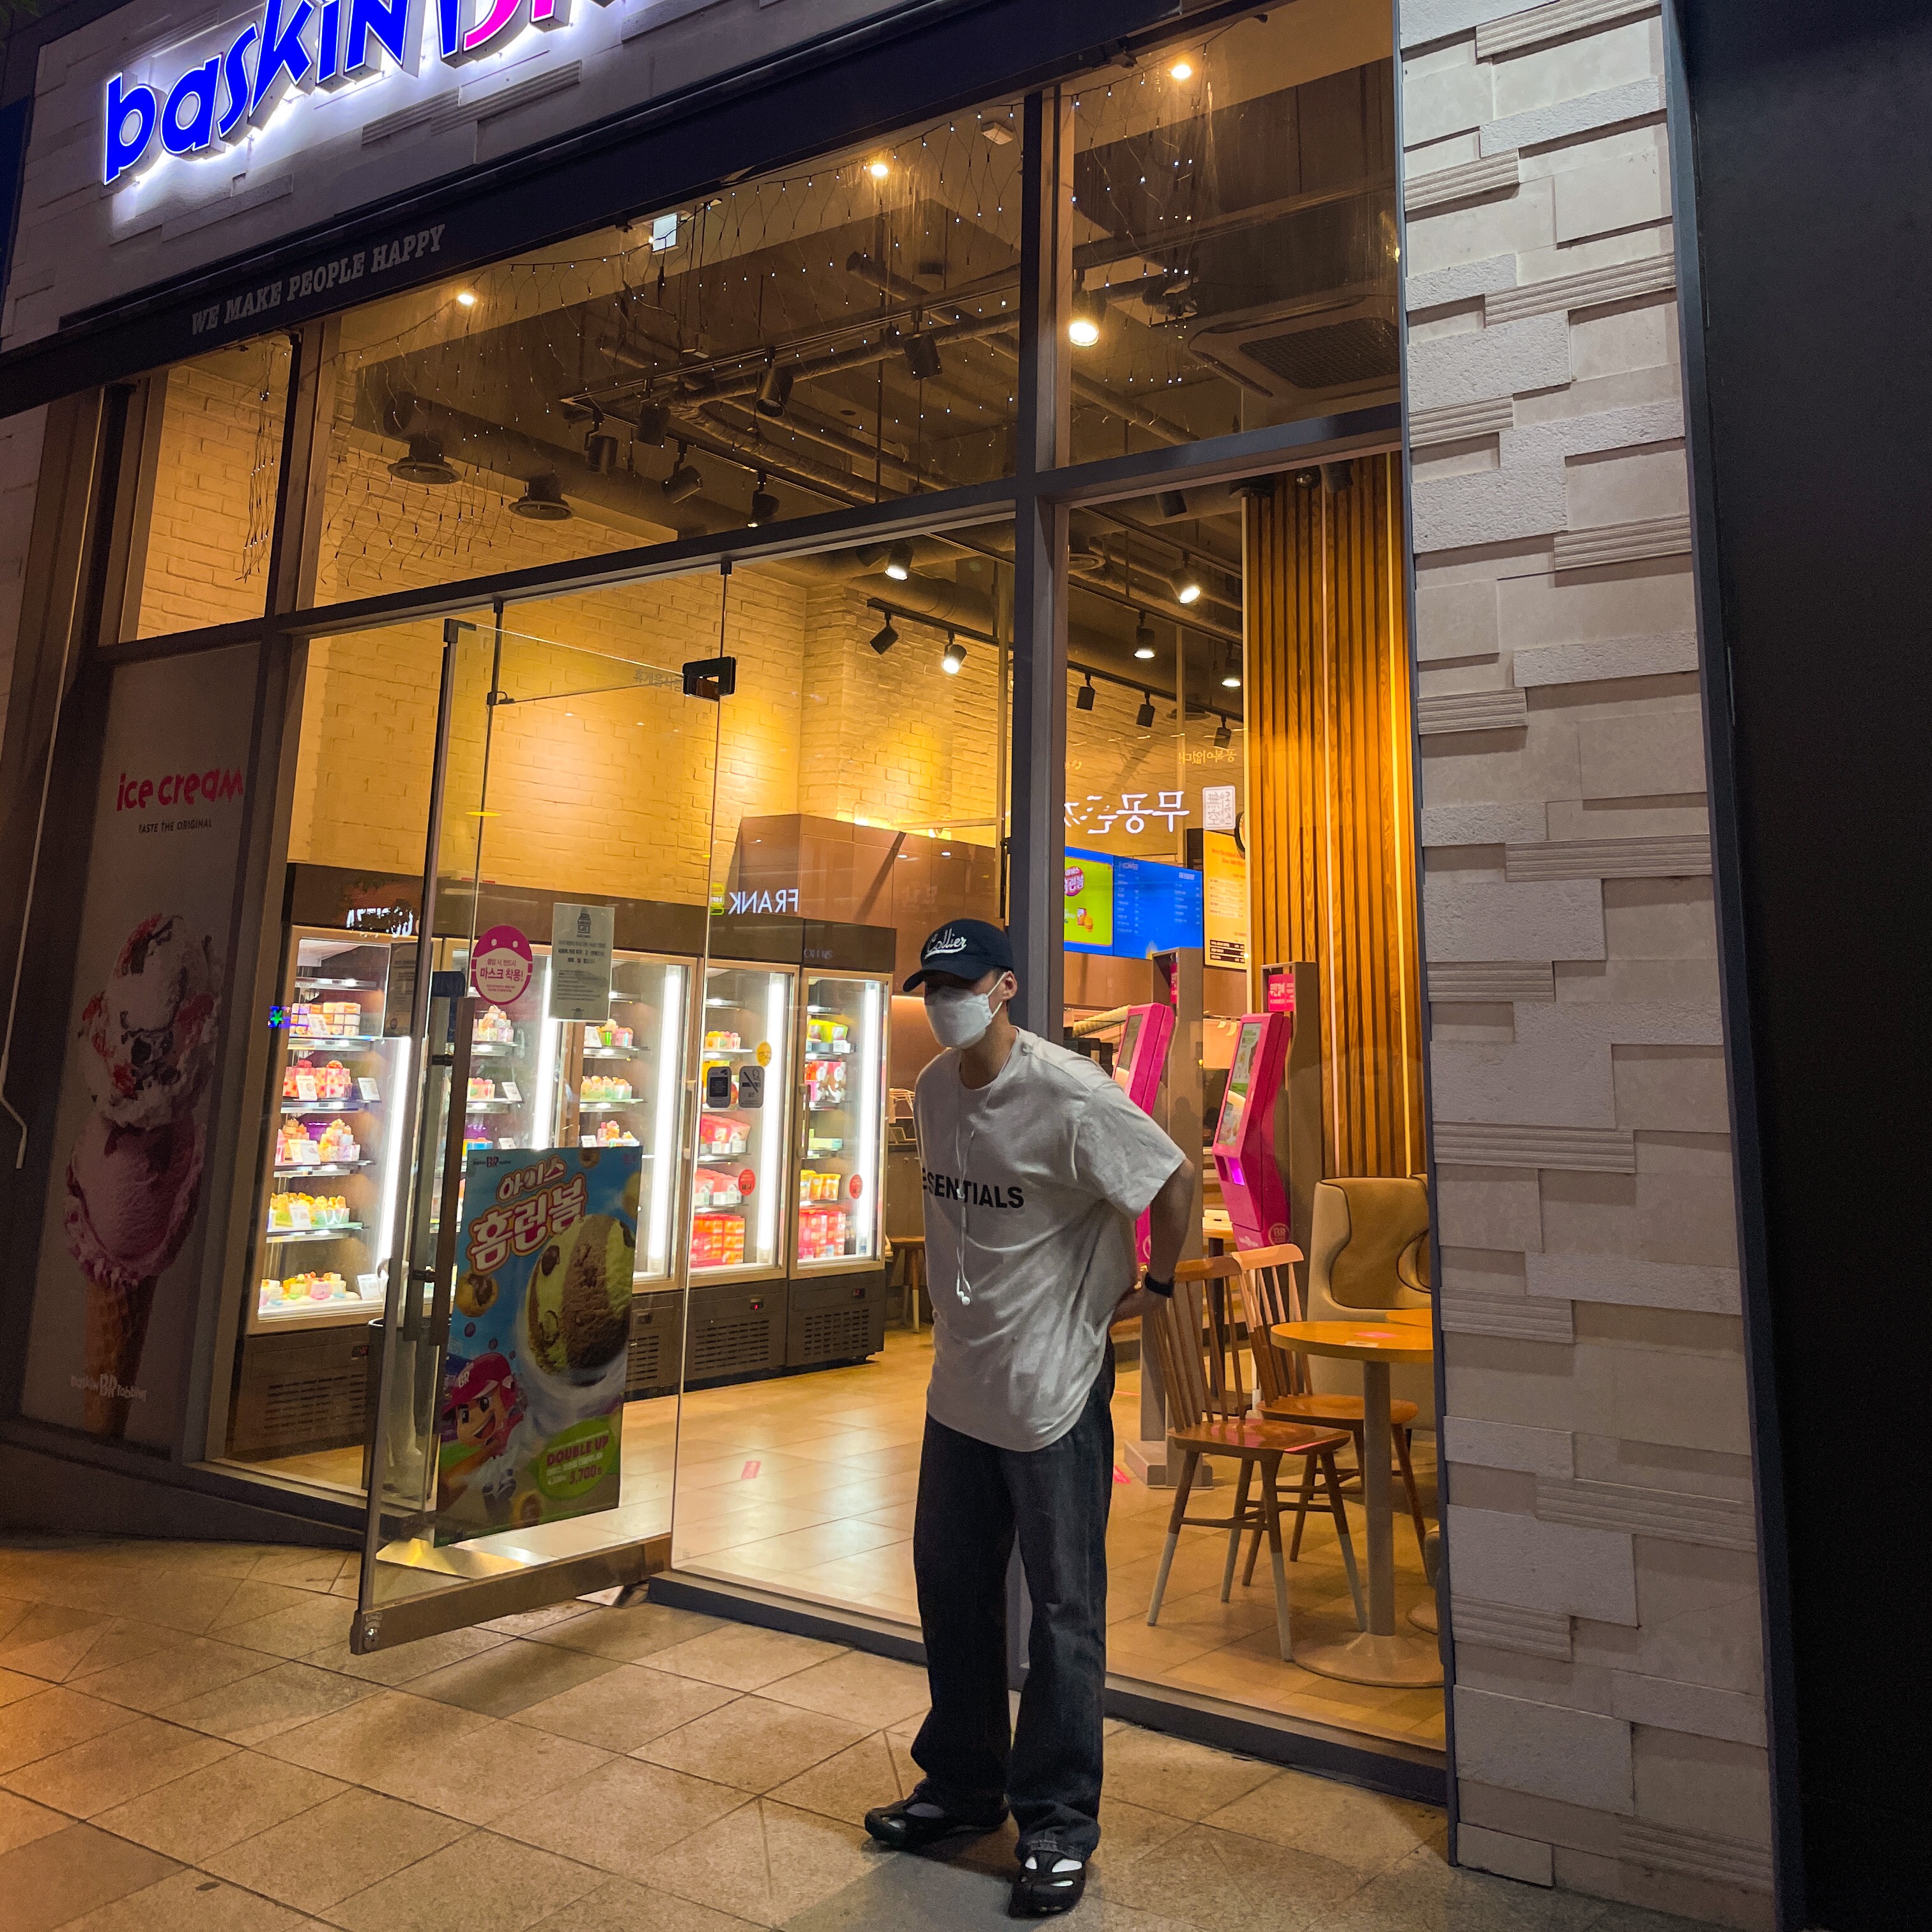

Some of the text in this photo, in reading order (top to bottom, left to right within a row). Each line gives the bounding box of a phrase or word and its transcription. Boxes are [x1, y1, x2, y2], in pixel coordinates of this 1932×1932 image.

[192, 224, 446, 335] WE MAKE PEOPLE HAPPY
[116, 766, 244, 811] ice cream
[139, 818, 213, 834] TASTE THE ORIGINAL
[480, 967, 523, 982] 마스크 착용!
[486, 1156, 500, 1168] BR
[498, 1155, 566, 1202] 아이스
[470, 1176, 585, 1271] 홈런볼
[547, 1441, 592, 1467] DOUBLE
[595, 1435, 609, 1451] UP
